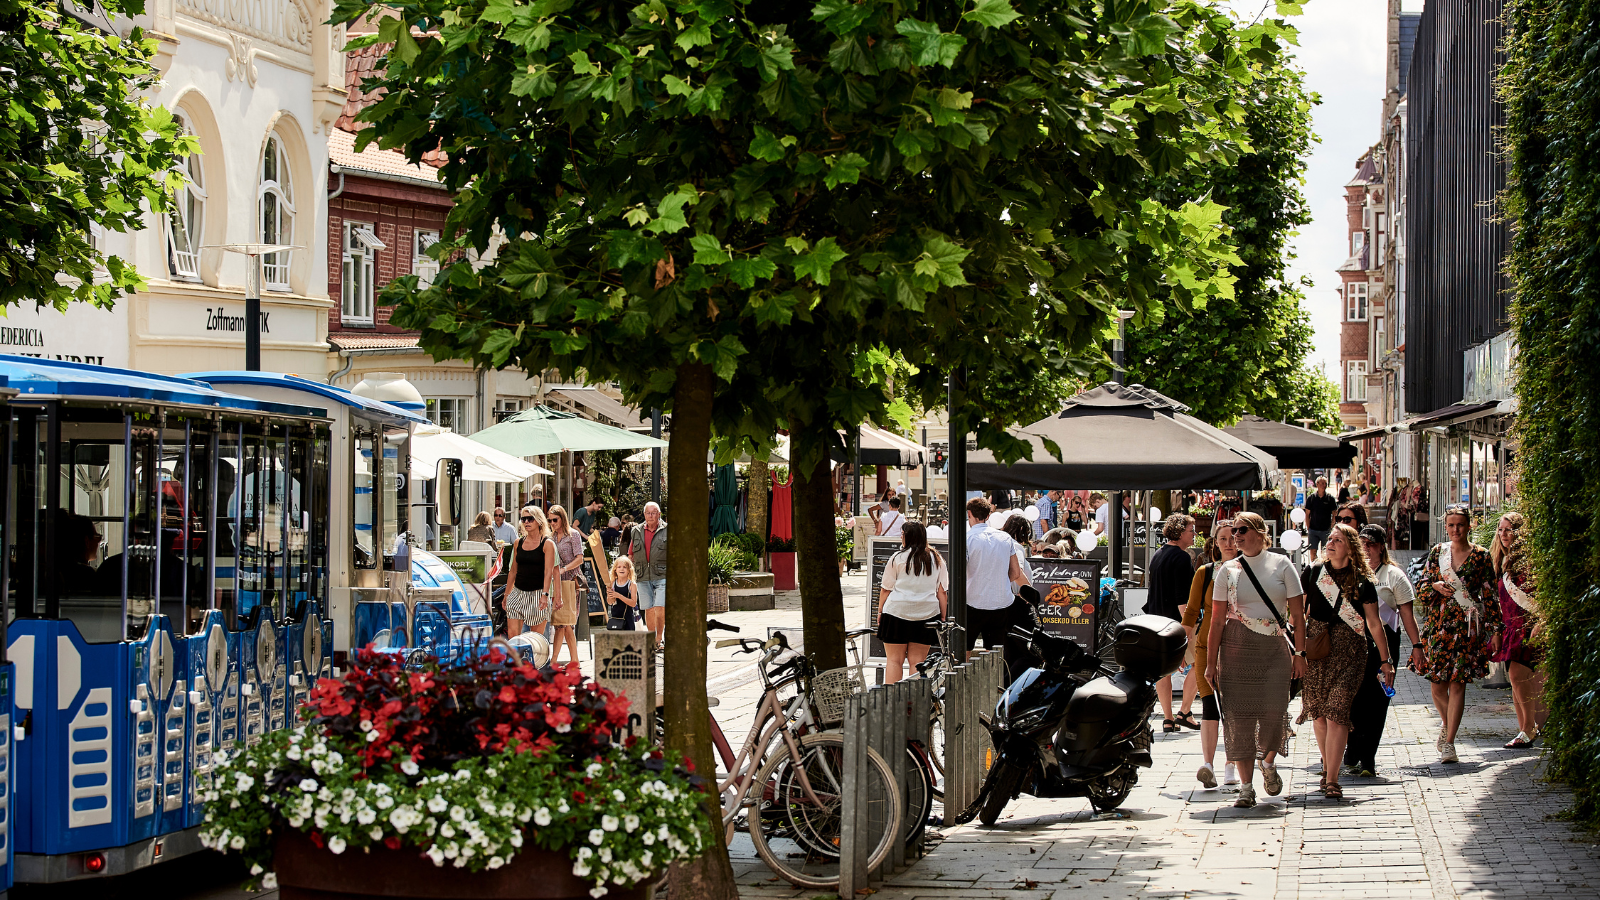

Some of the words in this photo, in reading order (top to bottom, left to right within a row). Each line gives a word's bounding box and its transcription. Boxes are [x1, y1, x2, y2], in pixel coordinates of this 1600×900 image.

[207, 307, 245, 332] Zoffmann
[0, 327, 44, 347] EDERICIA
[1038, 603, 1062, 617] GER
